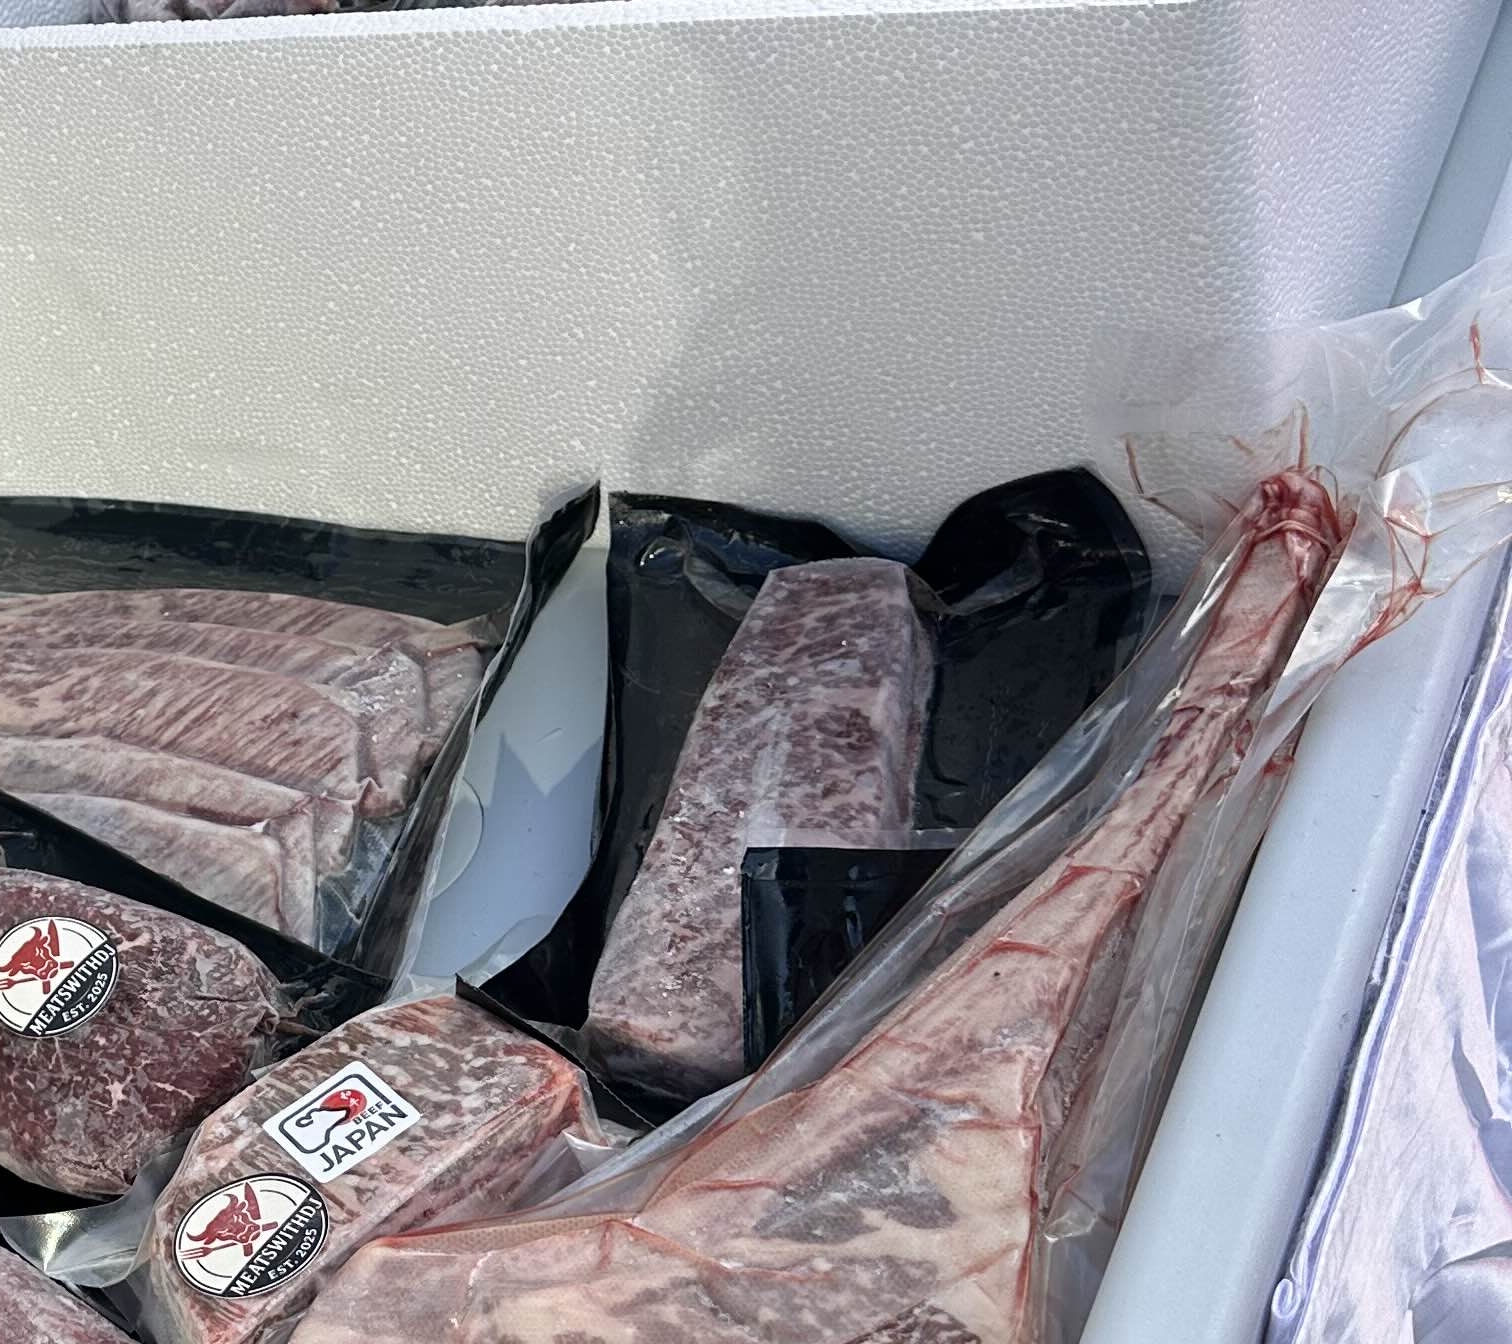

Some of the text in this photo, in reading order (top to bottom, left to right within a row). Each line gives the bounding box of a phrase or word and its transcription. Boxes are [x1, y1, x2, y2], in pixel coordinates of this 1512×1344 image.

[30, 944, 116, 1035] MEATSWITHDJ
[88, 972, 108, 1003] 2025
[353, 1101, 384, 1125] BEEF
[320, 1104, 408, 1172] JAPAN
[230, 1198, 323, 1296] MEATSWITHDJ
[296, 1228, 317, 1258] 2025
